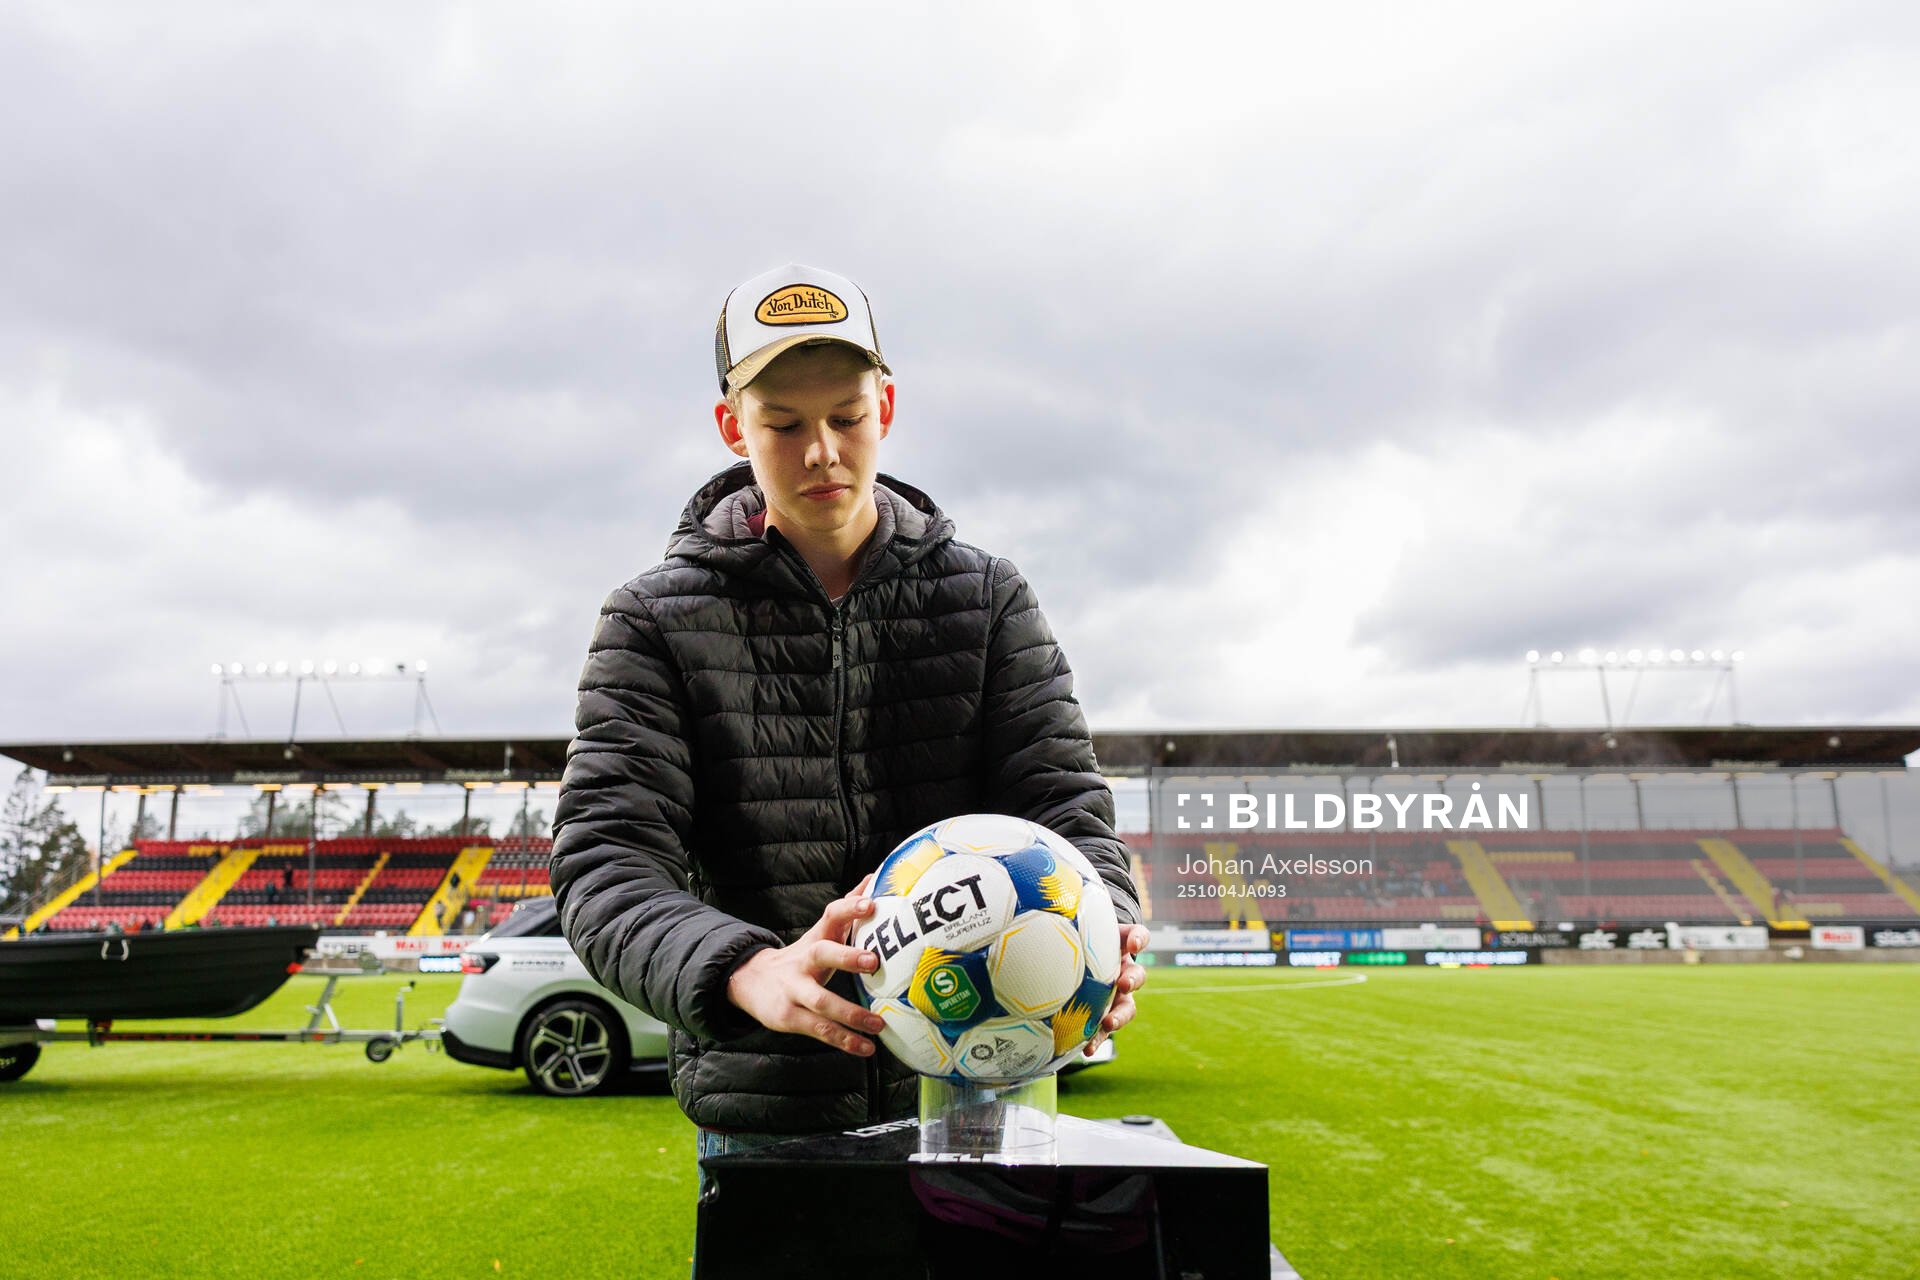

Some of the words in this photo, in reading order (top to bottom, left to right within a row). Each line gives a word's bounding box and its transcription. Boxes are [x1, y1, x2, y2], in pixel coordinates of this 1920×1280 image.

[766, 295, 794, 313] Von
[793, 291, 836, 313] Dutch
[863, 873, 987, 962] SELECT
[943, 909, 988, 933] BRILLANT
